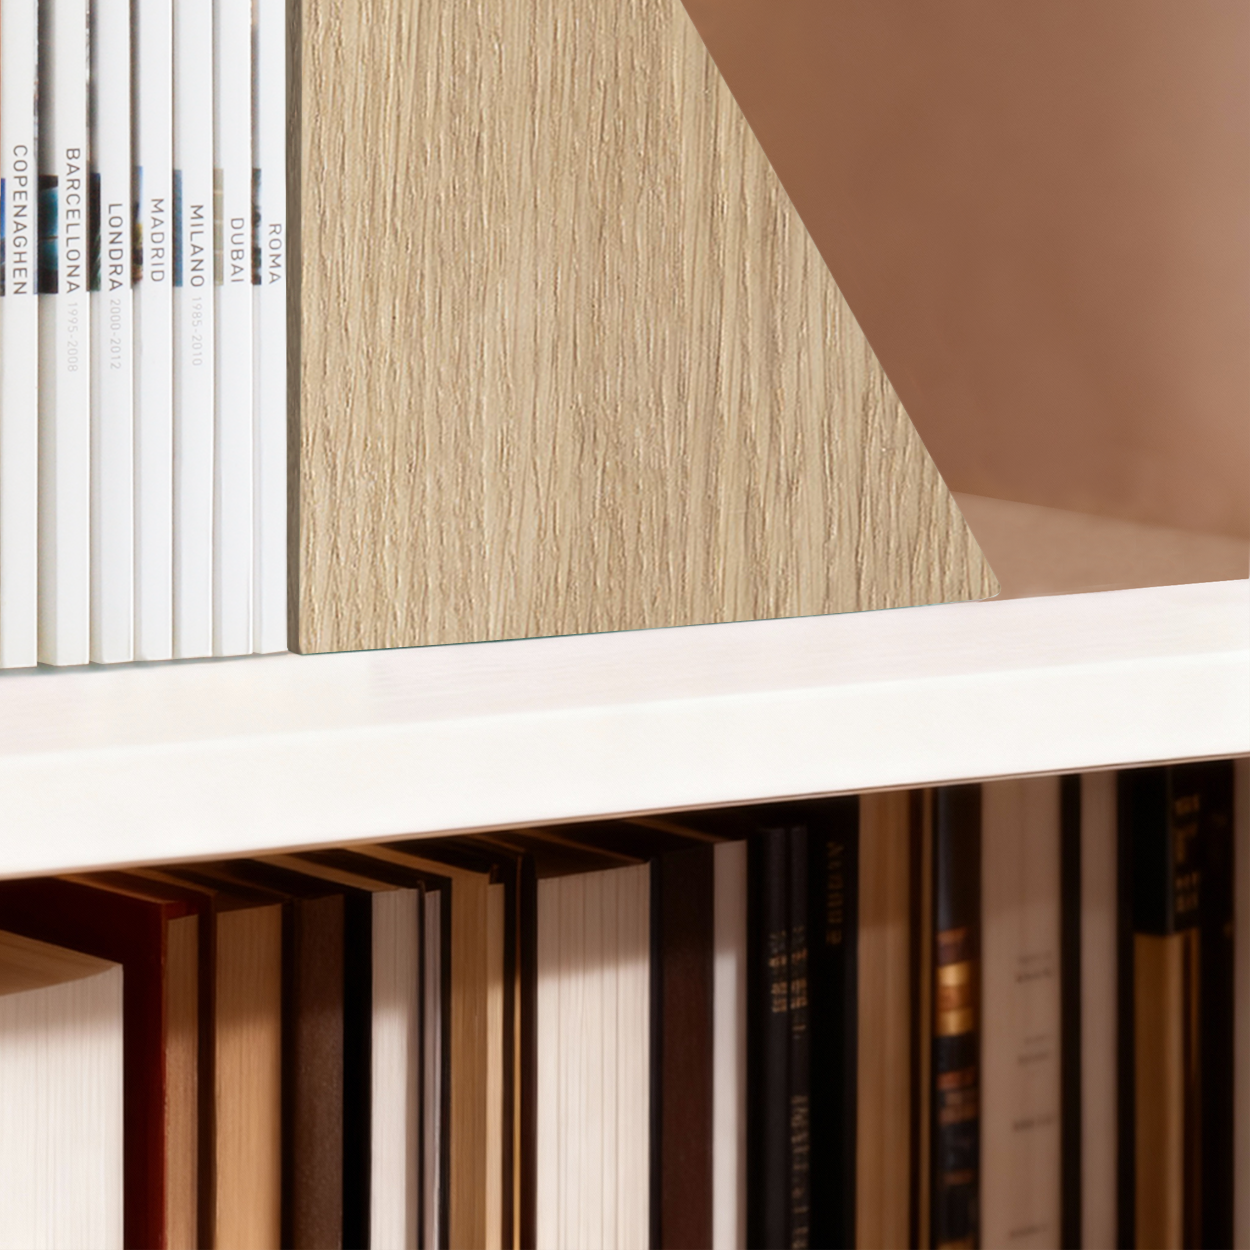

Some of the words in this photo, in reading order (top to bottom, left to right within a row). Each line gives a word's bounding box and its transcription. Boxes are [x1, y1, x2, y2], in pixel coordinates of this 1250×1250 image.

[12, 145, 28, 295] COPENAGHEN
[66, 148, 81, 294] BARCELLONA
[108, 203, 124, 292] LONDRA
[150, 198, 165, 282] MADRID
[190, 205, 205, 287] MILANO
[230, 218, 245, 282] DUBAI
[268, 223, 282, 284] ROMA
[68, 303, 78, 372] 1995-2008
[110, 299, 121, 369] 2000-2012
[192, 297, 202, 365] 1985-2010
